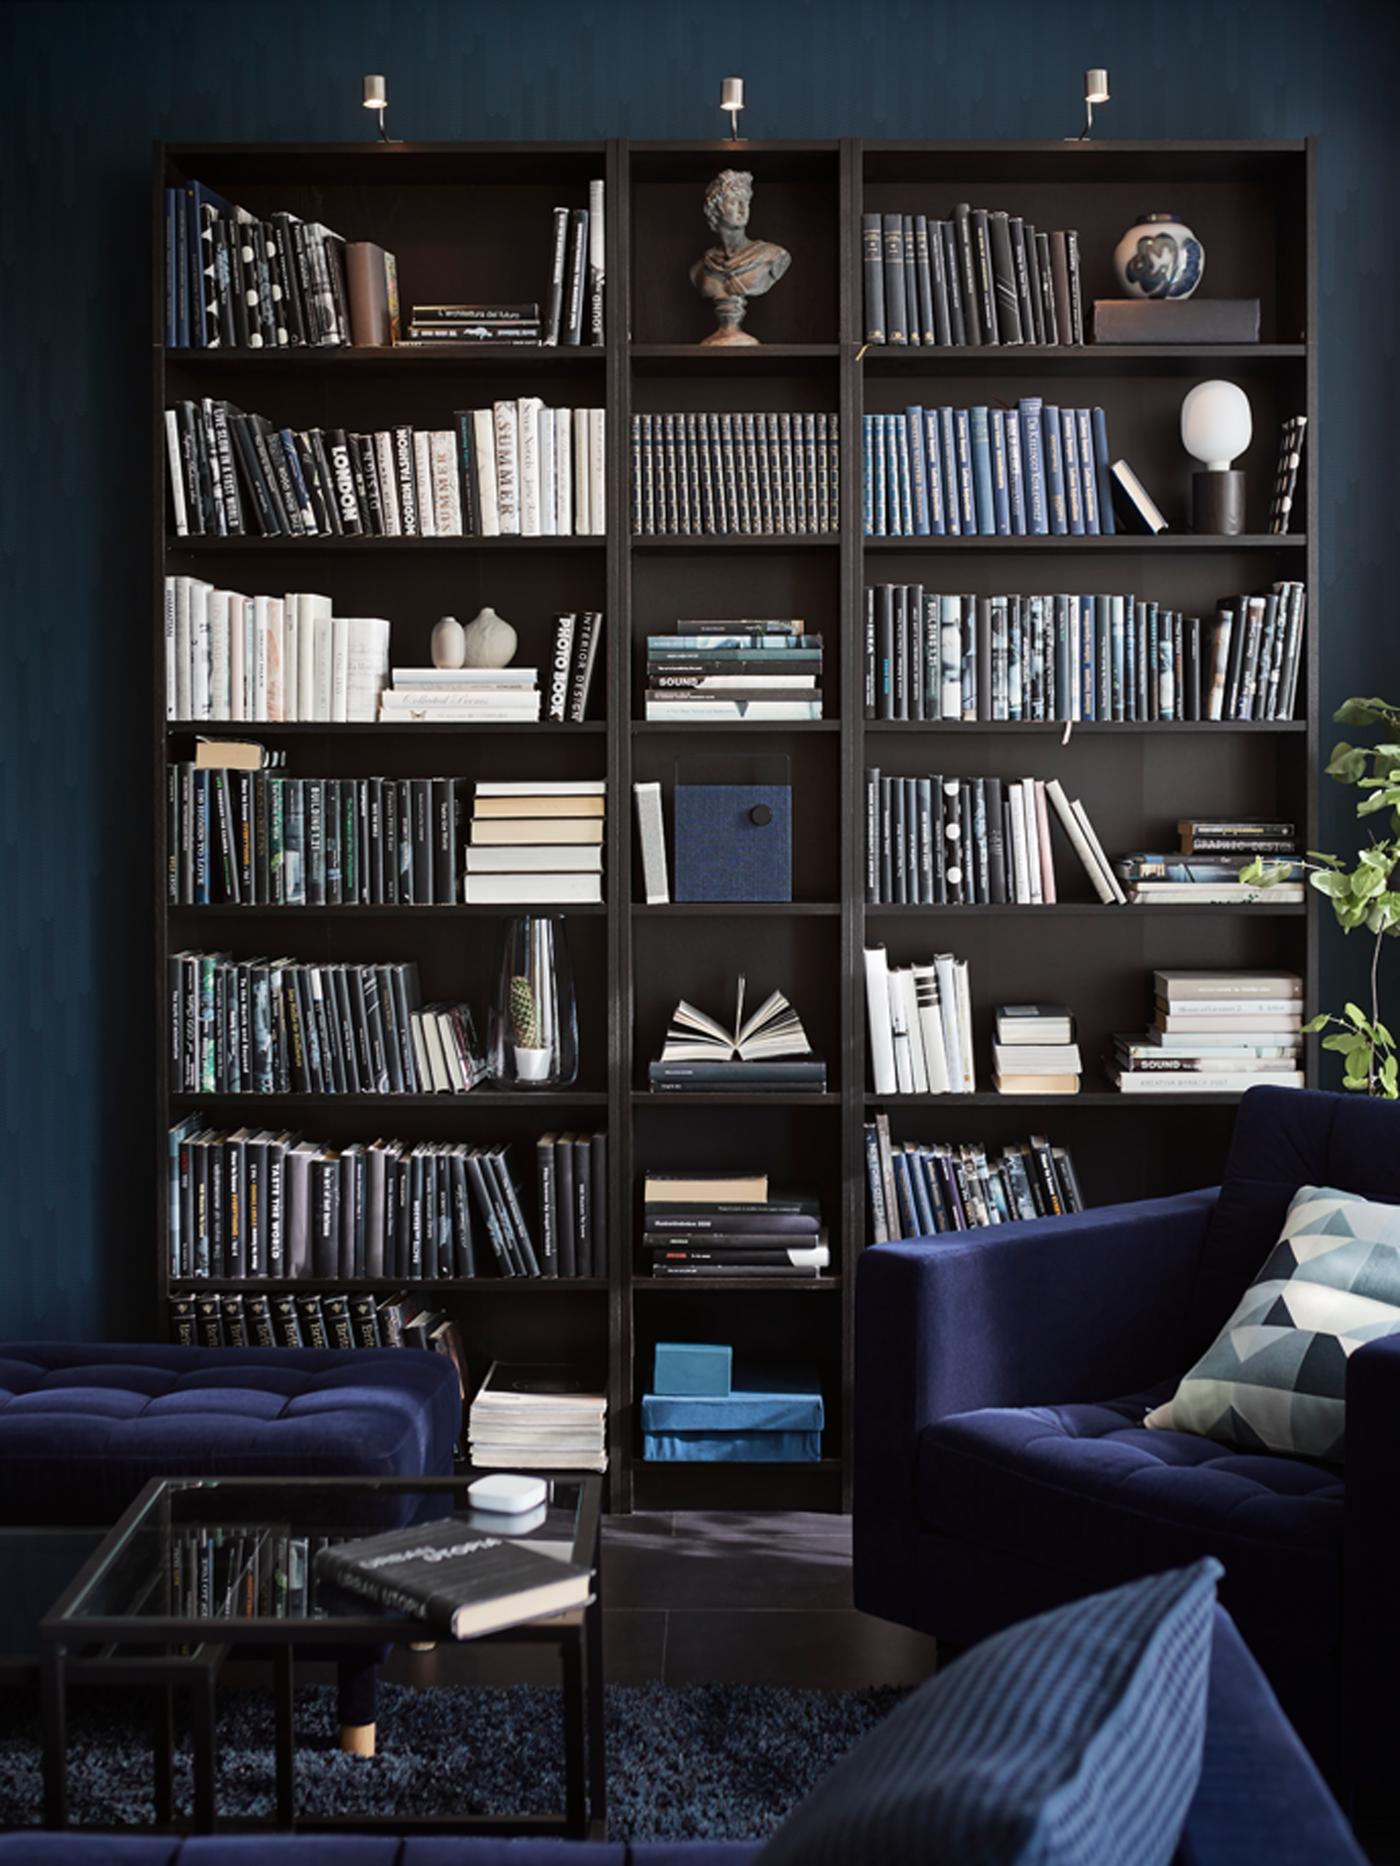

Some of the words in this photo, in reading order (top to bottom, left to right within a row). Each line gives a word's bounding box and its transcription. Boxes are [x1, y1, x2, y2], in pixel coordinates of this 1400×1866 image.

[592, 294, 601, 333] SOUND
[214, 408, 226, 427] LIVE
[216, 429, 229, 453] SLOW
[396, 428, 411, 480] FASHION
[219, 454, 231, 465] IN
[221, 465, 232, 473] A
[497, 420, 514, 516] SUMMER
[222, 473, 234, 495] FAST
[330, 445, 358, 522] LONDON
[362, 449, 380, 510] DESIGN
[436, 451, 451, 532] SUMMER
[224, 496, 238, 527] WORLD
[400, 481, 415, 535] MODERN
[554, 616, 571, 670] PHOTO
[577, 612, 593, 669] INTERIOR
[550, 671, 568, 716] BOOK
[570, 674, 584, 719] DESIGN
[658, 677, 698, 687] SOUND
[310, 787, 320, 833] BUILDING
[239, 978, 247, 987] To
[239, 989, 247, 1002] the
[240, 1028, 248, 1042] and
[241, 1044, 249, 1072] Beyond
[1140, 1061, 1180, 1070] SOUND
[271, 1163, 280, 1195] TASTE
[272, 1199, 280, 1219] THE
[272, 1221, 280, 1259] WORLD
